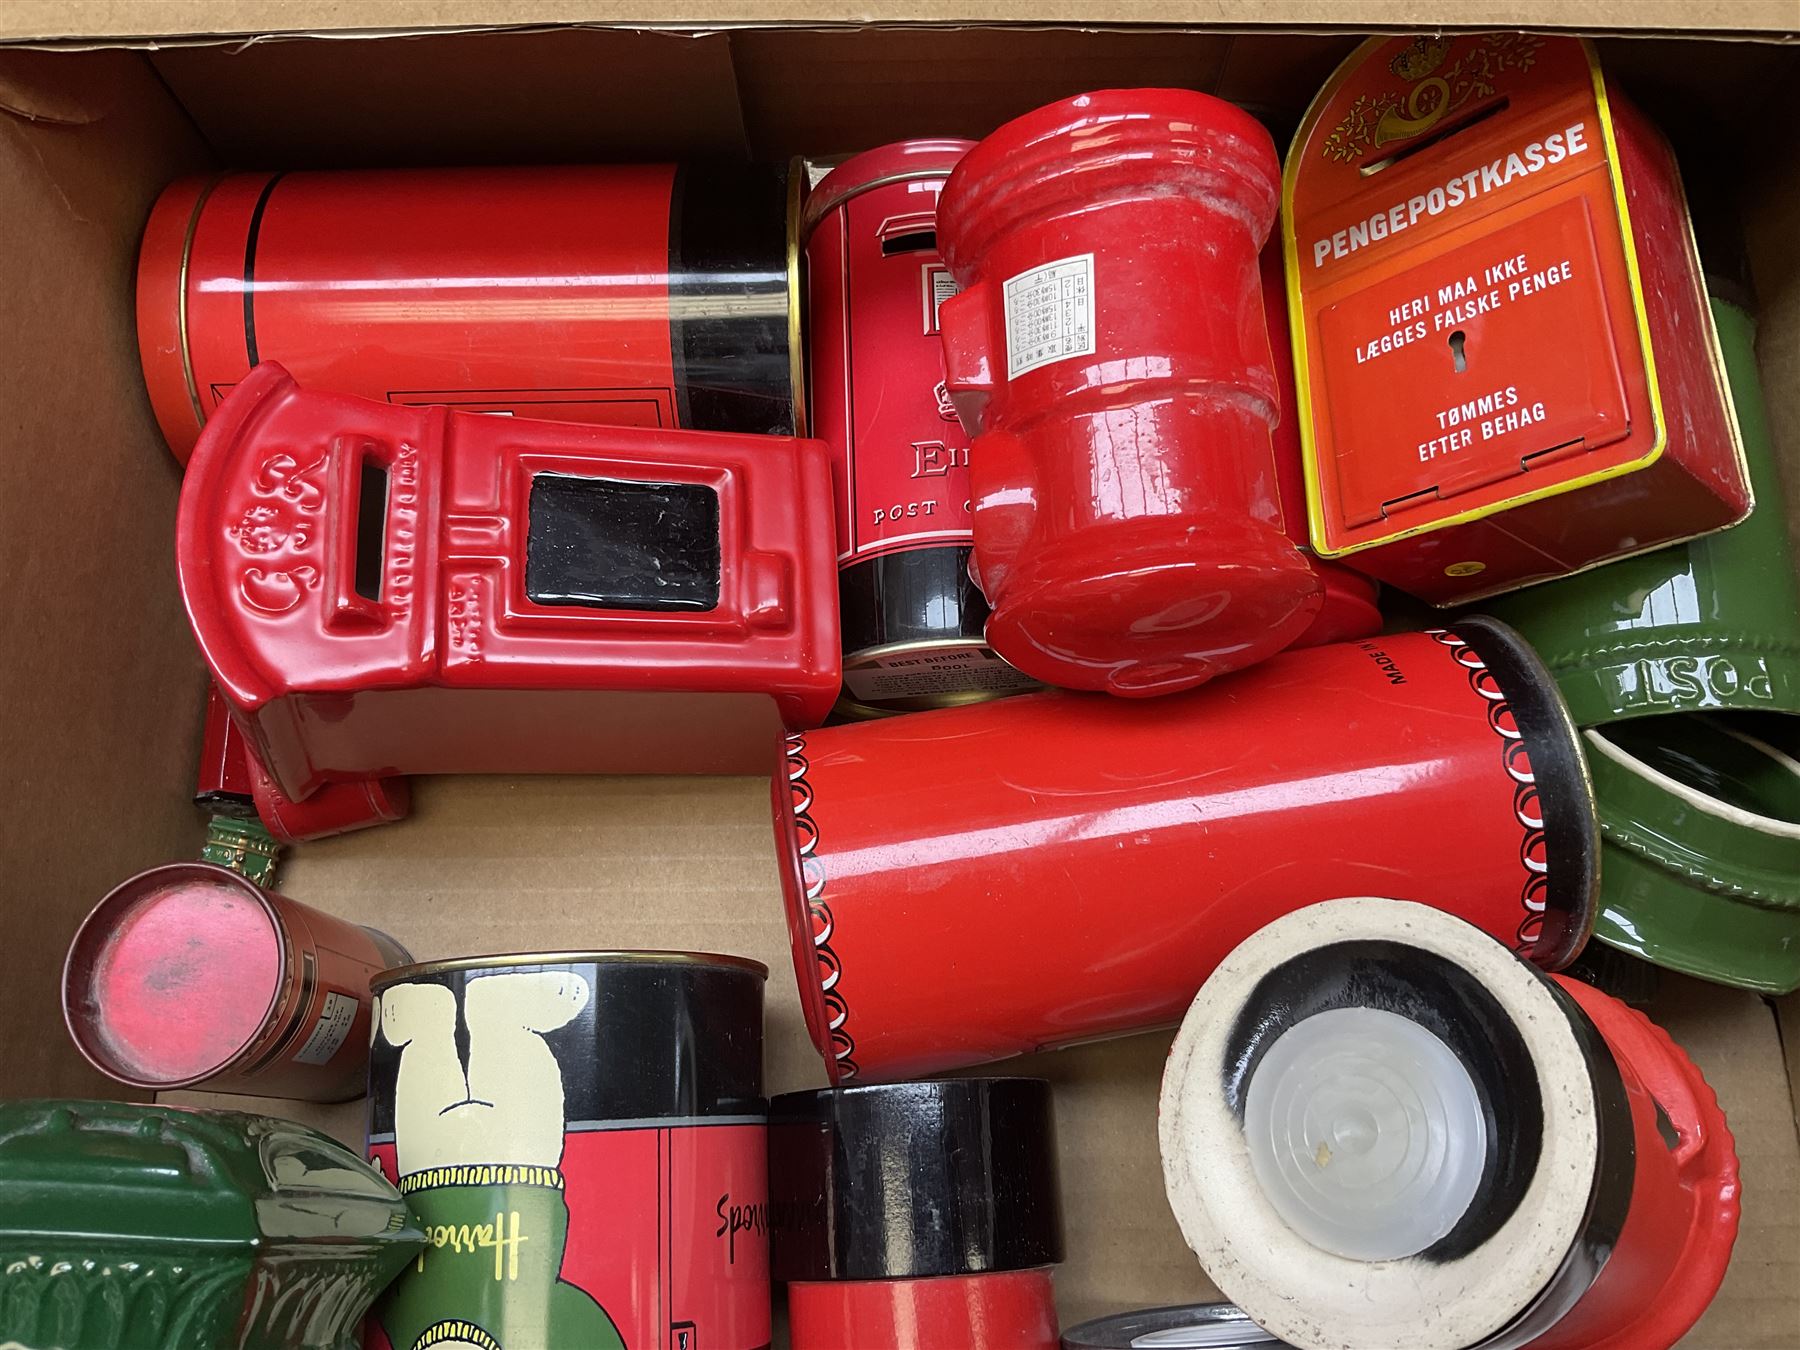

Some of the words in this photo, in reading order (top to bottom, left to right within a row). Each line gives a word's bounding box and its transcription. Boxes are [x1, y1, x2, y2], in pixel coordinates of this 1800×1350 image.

[1313, 122, 1589, 268] PENGEPOSTKASSE
[1356, 321, 1427, 364] LÆGGES
[1434, 293, 1502, 332] FALSKE
[1509, 261, 1573, 301] PENGE
[1388, 295, 1430, 327] HERI
[1437, 276, 1478, 307] MAA
[1485, 254, 1528, 287] IKKE
[1418, 430, 1474, 462] EFTER
[1481, 402, 1546, 441] BEHAG
[1436, 386, 1519, 430] TØMMES
[873, 500, 938, 525] POST
[888, 659, 921, 668] BEST
[924, 653, 973, 664] BEFORE
[1369, 651, 1408, 685] MADE
[1624, 656, 1774, 708] POST
[416, 1210, 529, 1281] Harro
[716, 1193, 768, 1265] rrods
